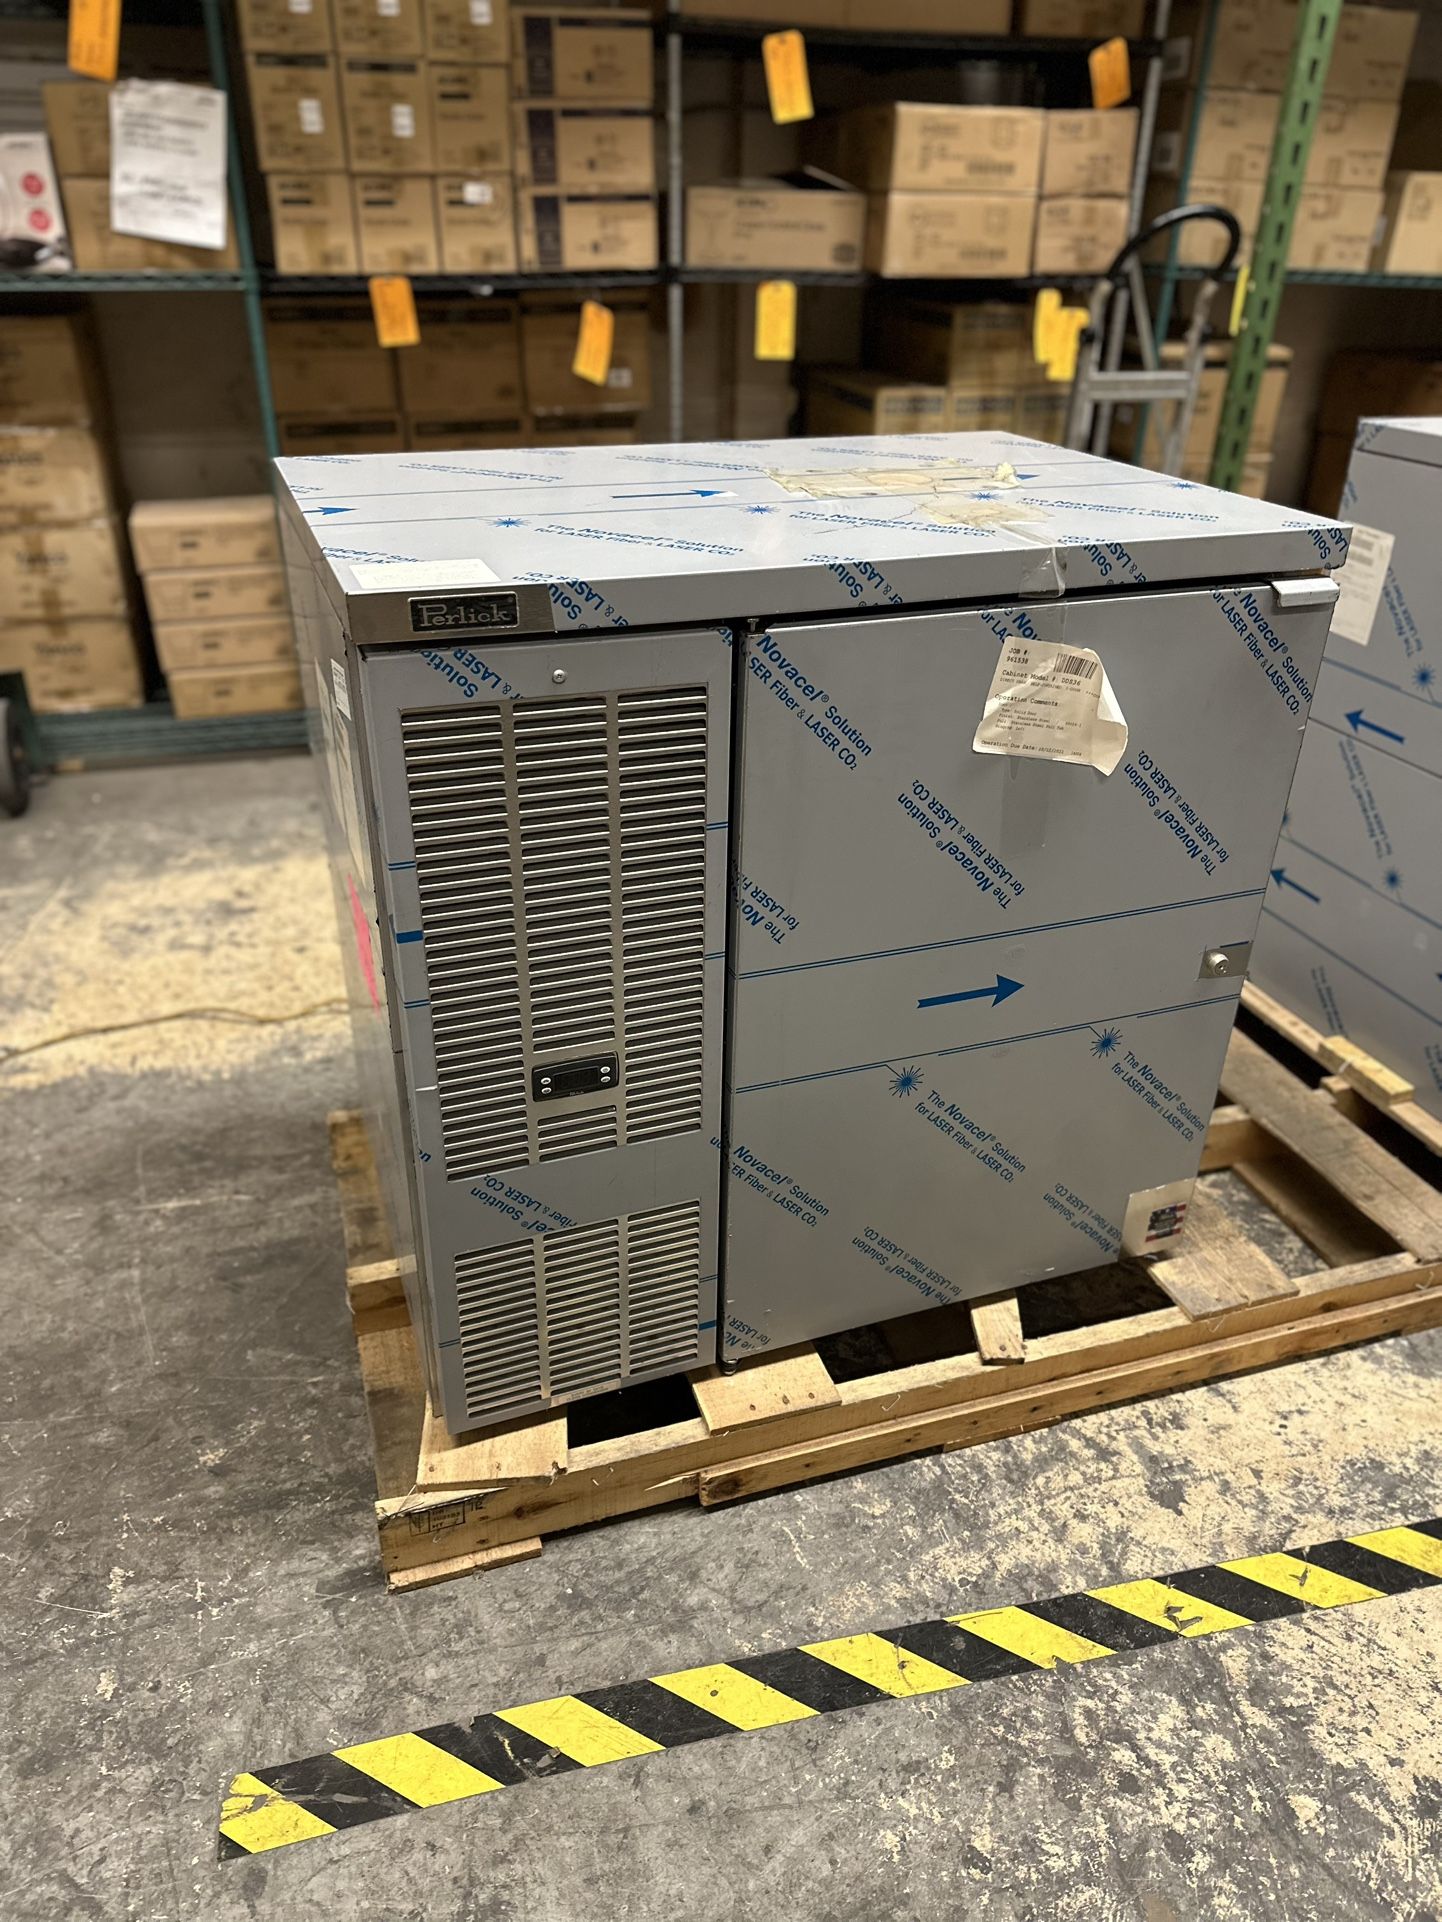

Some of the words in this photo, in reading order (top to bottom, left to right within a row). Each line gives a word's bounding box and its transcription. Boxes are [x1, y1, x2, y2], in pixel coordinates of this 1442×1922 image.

[558, 531, 603, 540] LASER
[657, 543, 705, 552] LASER
[675, 540, 743, 552] Solution
[417, 603, 511, 627] Perlick
[1221, 600, 1247, 636] LASER
[1243, 632, 1264, 660] Fiber
[1265, 664, 1290, 698] LASER
[453, 648, 502, 689] LASER
[1002, 669, 1028, 679] Cabinet
[1030, 674, 1049, 682] Model
[1282, 656, 1312, 703] Solution
[994, 693, 1028, 703] Operation
[769, 680, 800, 712] Fiber
[796, 709, 805, 719] &
[804, 714, 841, 752] LASER
[824, 705, 872, 757] Solution
[981, 740, 1008, 748] Operation
[1123, 763, 1160, 808] Solution
[1150, 767, 1177, 800] LASER
[897, 793, 942, 839] Solution
[928, 796, 959, 831] LASER
[1178, 801, 1199, 826] Fiber
[962, 832, 985, 858] Fiber
[1194, 820, 1220, 852] LASER
[984, 851, 1013, 882] LASER
[1200, 854, 1217, 876] The
[1216, 847, 1230, 864] for
[991, 886, 1012, 909] The
[1010, 879, 1026, 898] for
[750, 886, 785, 918] LASER
[764, 921, 785, 944] The
[782, 915, 800, 931] for
[1111, 1062, 1125, 1076] for
[1121, 1072, 1146, 1095] LASER
[1142, 1091, 1160, 1110] Fiber
[1162, 1109, 1184, 1131] LASER
[1123, 1051, 1139, 1069] The
[1176, 1102, 1205, 1132] Solution
[914, 1102, 929, 1115] for
[927, 1111, 954, 1136] LASER
[952, 1131, 973, 1150] Fiber
[976, 1149, 1002, 1172] LASER
[927, 1090, 945, 1109] The
[991, 1142, 1026, 1173] Solution
[470, 1187, 523, 1220] Solution
[505, 1186, 542, 1211] LASER
[743, 1173, 769, 1193] Fiber
[766, 1190, 774, 1198] &
[773, 1193, 802, 1216] LASER
[789, 1185, 830, 1216] Solution
[1043, 1193, 1075, 1221] Solution
[1066, 1193, 1090, 1214] LASER
[1090, 1214, 1108, 1230] Fiber
[852, 1236, 889, 1266] Solution
[877, 1237, 904, 1258] LASER
[907, 1257, 928, 1274] Fiber
[926, 1269, 952, 1290] LASER
[949, 1285, 962, 1296] for
[729, 1318, 758, 1338] LASER
[757, 1334, 771, 1345] for
